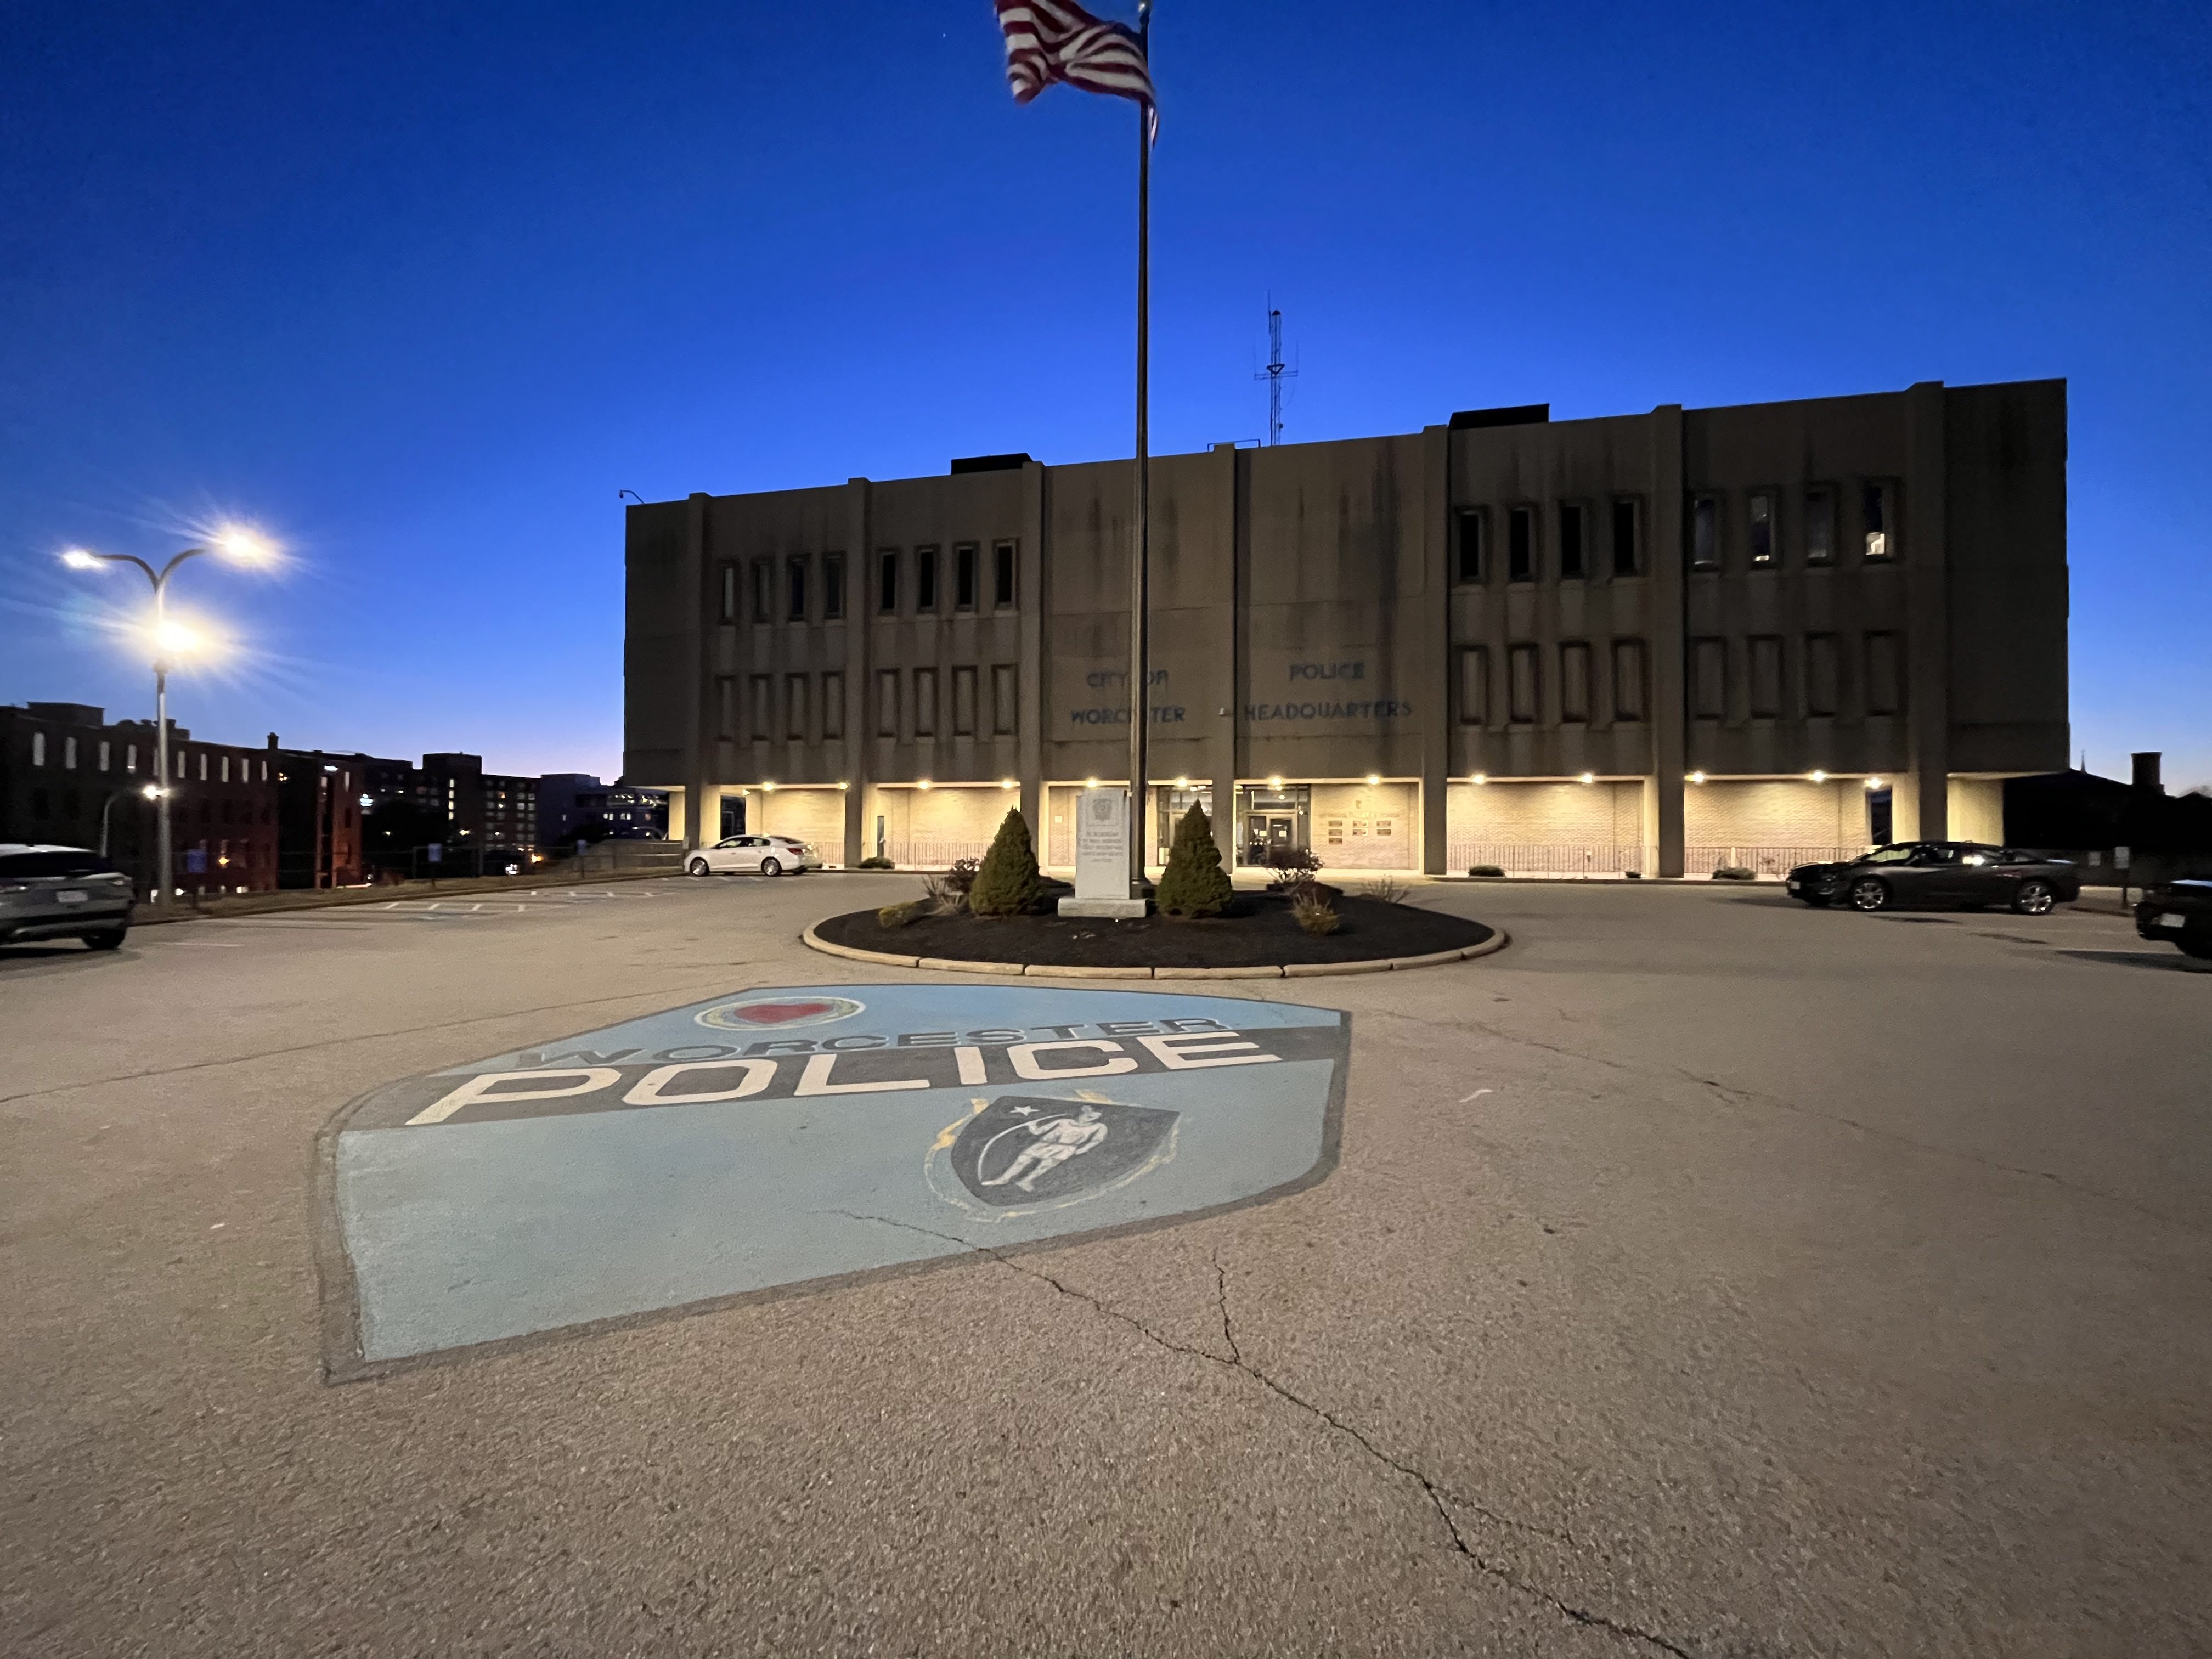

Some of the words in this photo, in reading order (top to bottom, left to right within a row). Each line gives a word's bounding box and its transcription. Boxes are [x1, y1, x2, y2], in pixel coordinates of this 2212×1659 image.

[1290, 662, 1365, 681] POLICE
[1071, 704, 1186, 725] WORCTER
[1244, 700, 1413, 721] HEADQUARTERS
[518, 1018, 1232, 1068] WORCESTER
[405, 1031, 1283, 1126] POLICE
